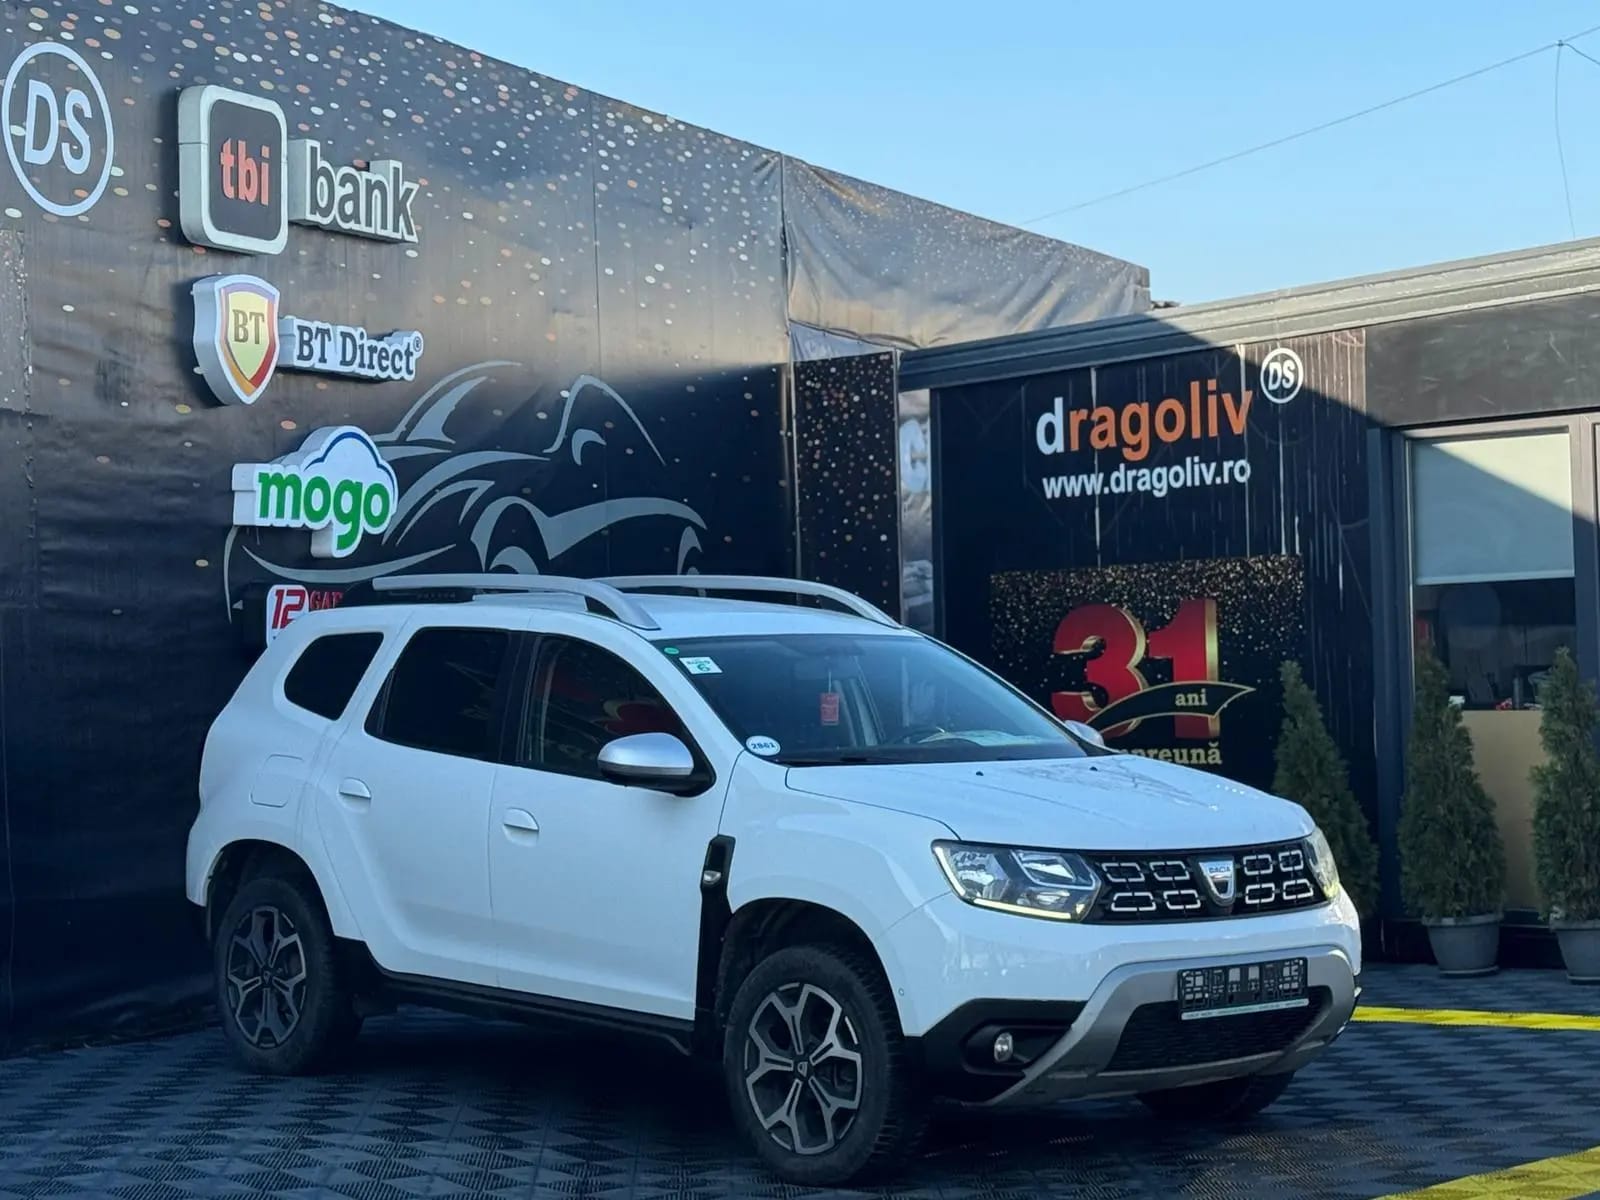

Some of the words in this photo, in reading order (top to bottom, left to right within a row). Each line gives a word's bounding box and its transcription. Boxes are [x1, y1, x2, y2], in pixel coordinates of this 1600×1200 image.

[24, 80, 93, 174] DS
[220, 138, 270, 206] tbi
[309, 144, 416, 240] bank
[232, 309, 265, 346] BT
[297, 325, 332, 363] BT
[1268, 360, 1296, 391] DS
[1036, 379, 1253, 461] dragoliv
[1042, 455, 1251, 498] www.dragoliv.ro
[259, 473, 389, 550] mogo
[272, 589, 307, 629] 12
[1051, 599, 1220, 738] 31
[1175, 688, 1208, 706] ani
